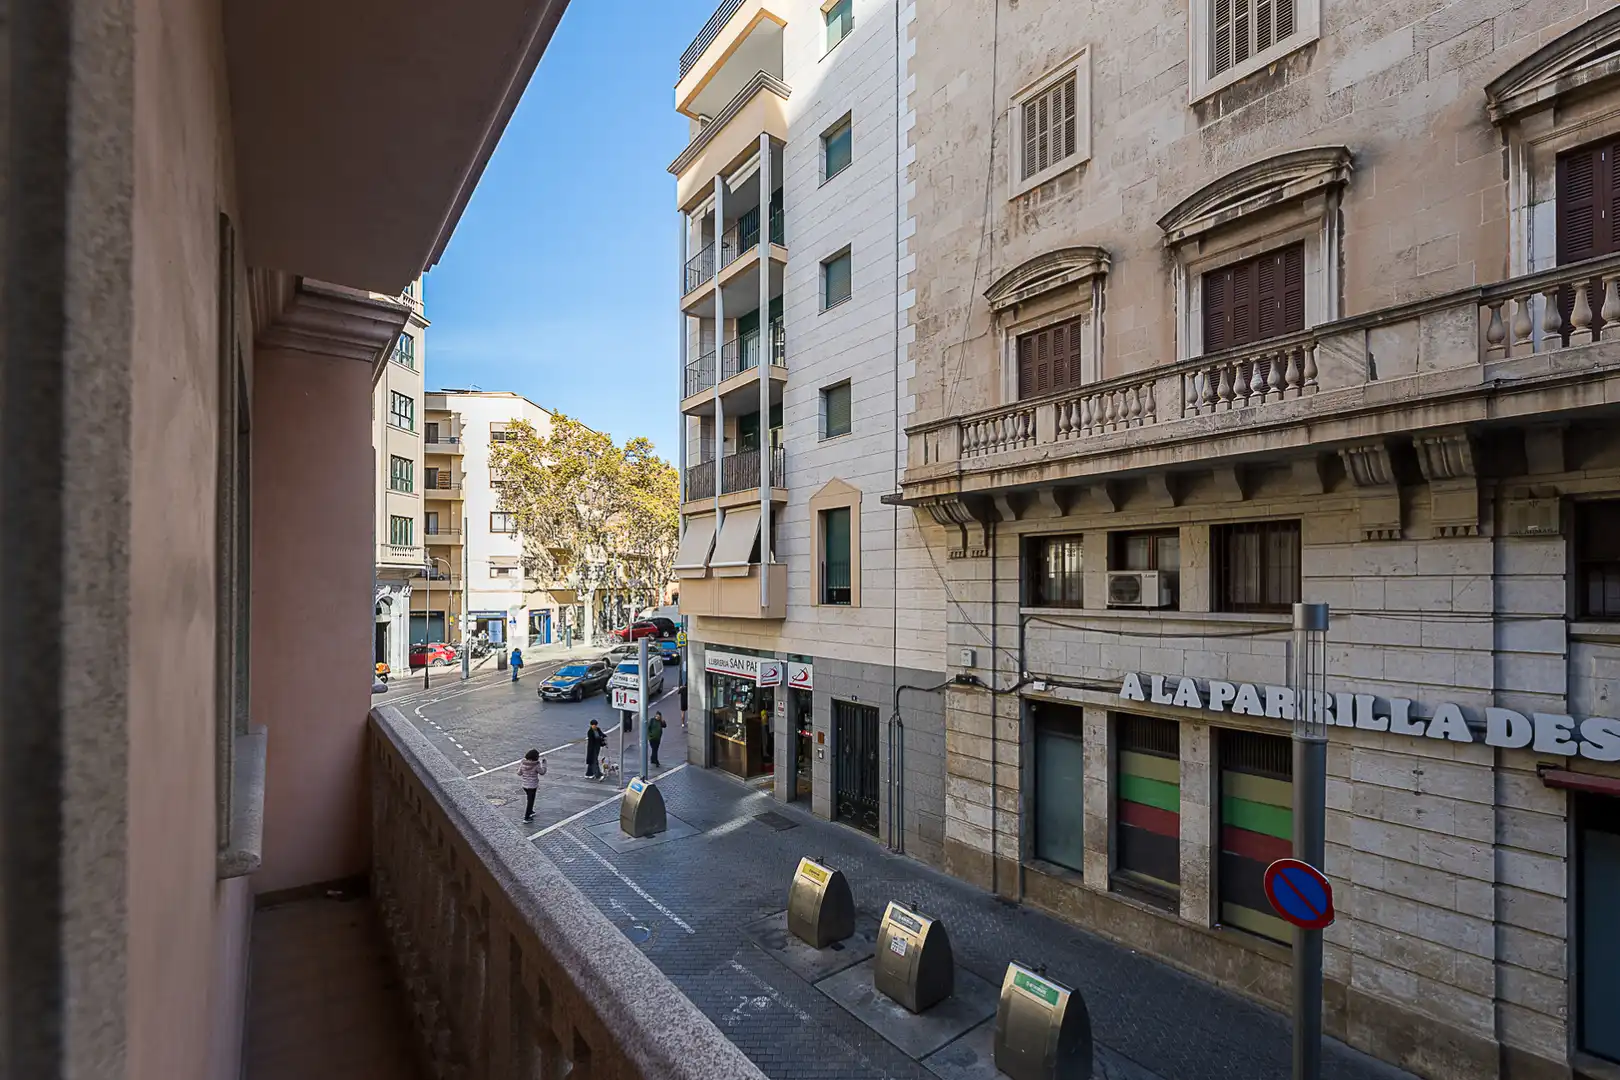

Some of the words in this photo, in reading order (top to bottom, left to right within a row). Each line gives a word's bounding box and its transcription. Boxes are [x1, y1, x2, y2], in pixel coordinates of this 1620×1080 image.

[729, 657, 745, 670] SAN
[1119, 672, 1145, 702] A
[1150, 674, 1202, 709] LA
[1208, 680, 1474, 744] PARRILLA
[1485, 706, 1620, 762] DES
